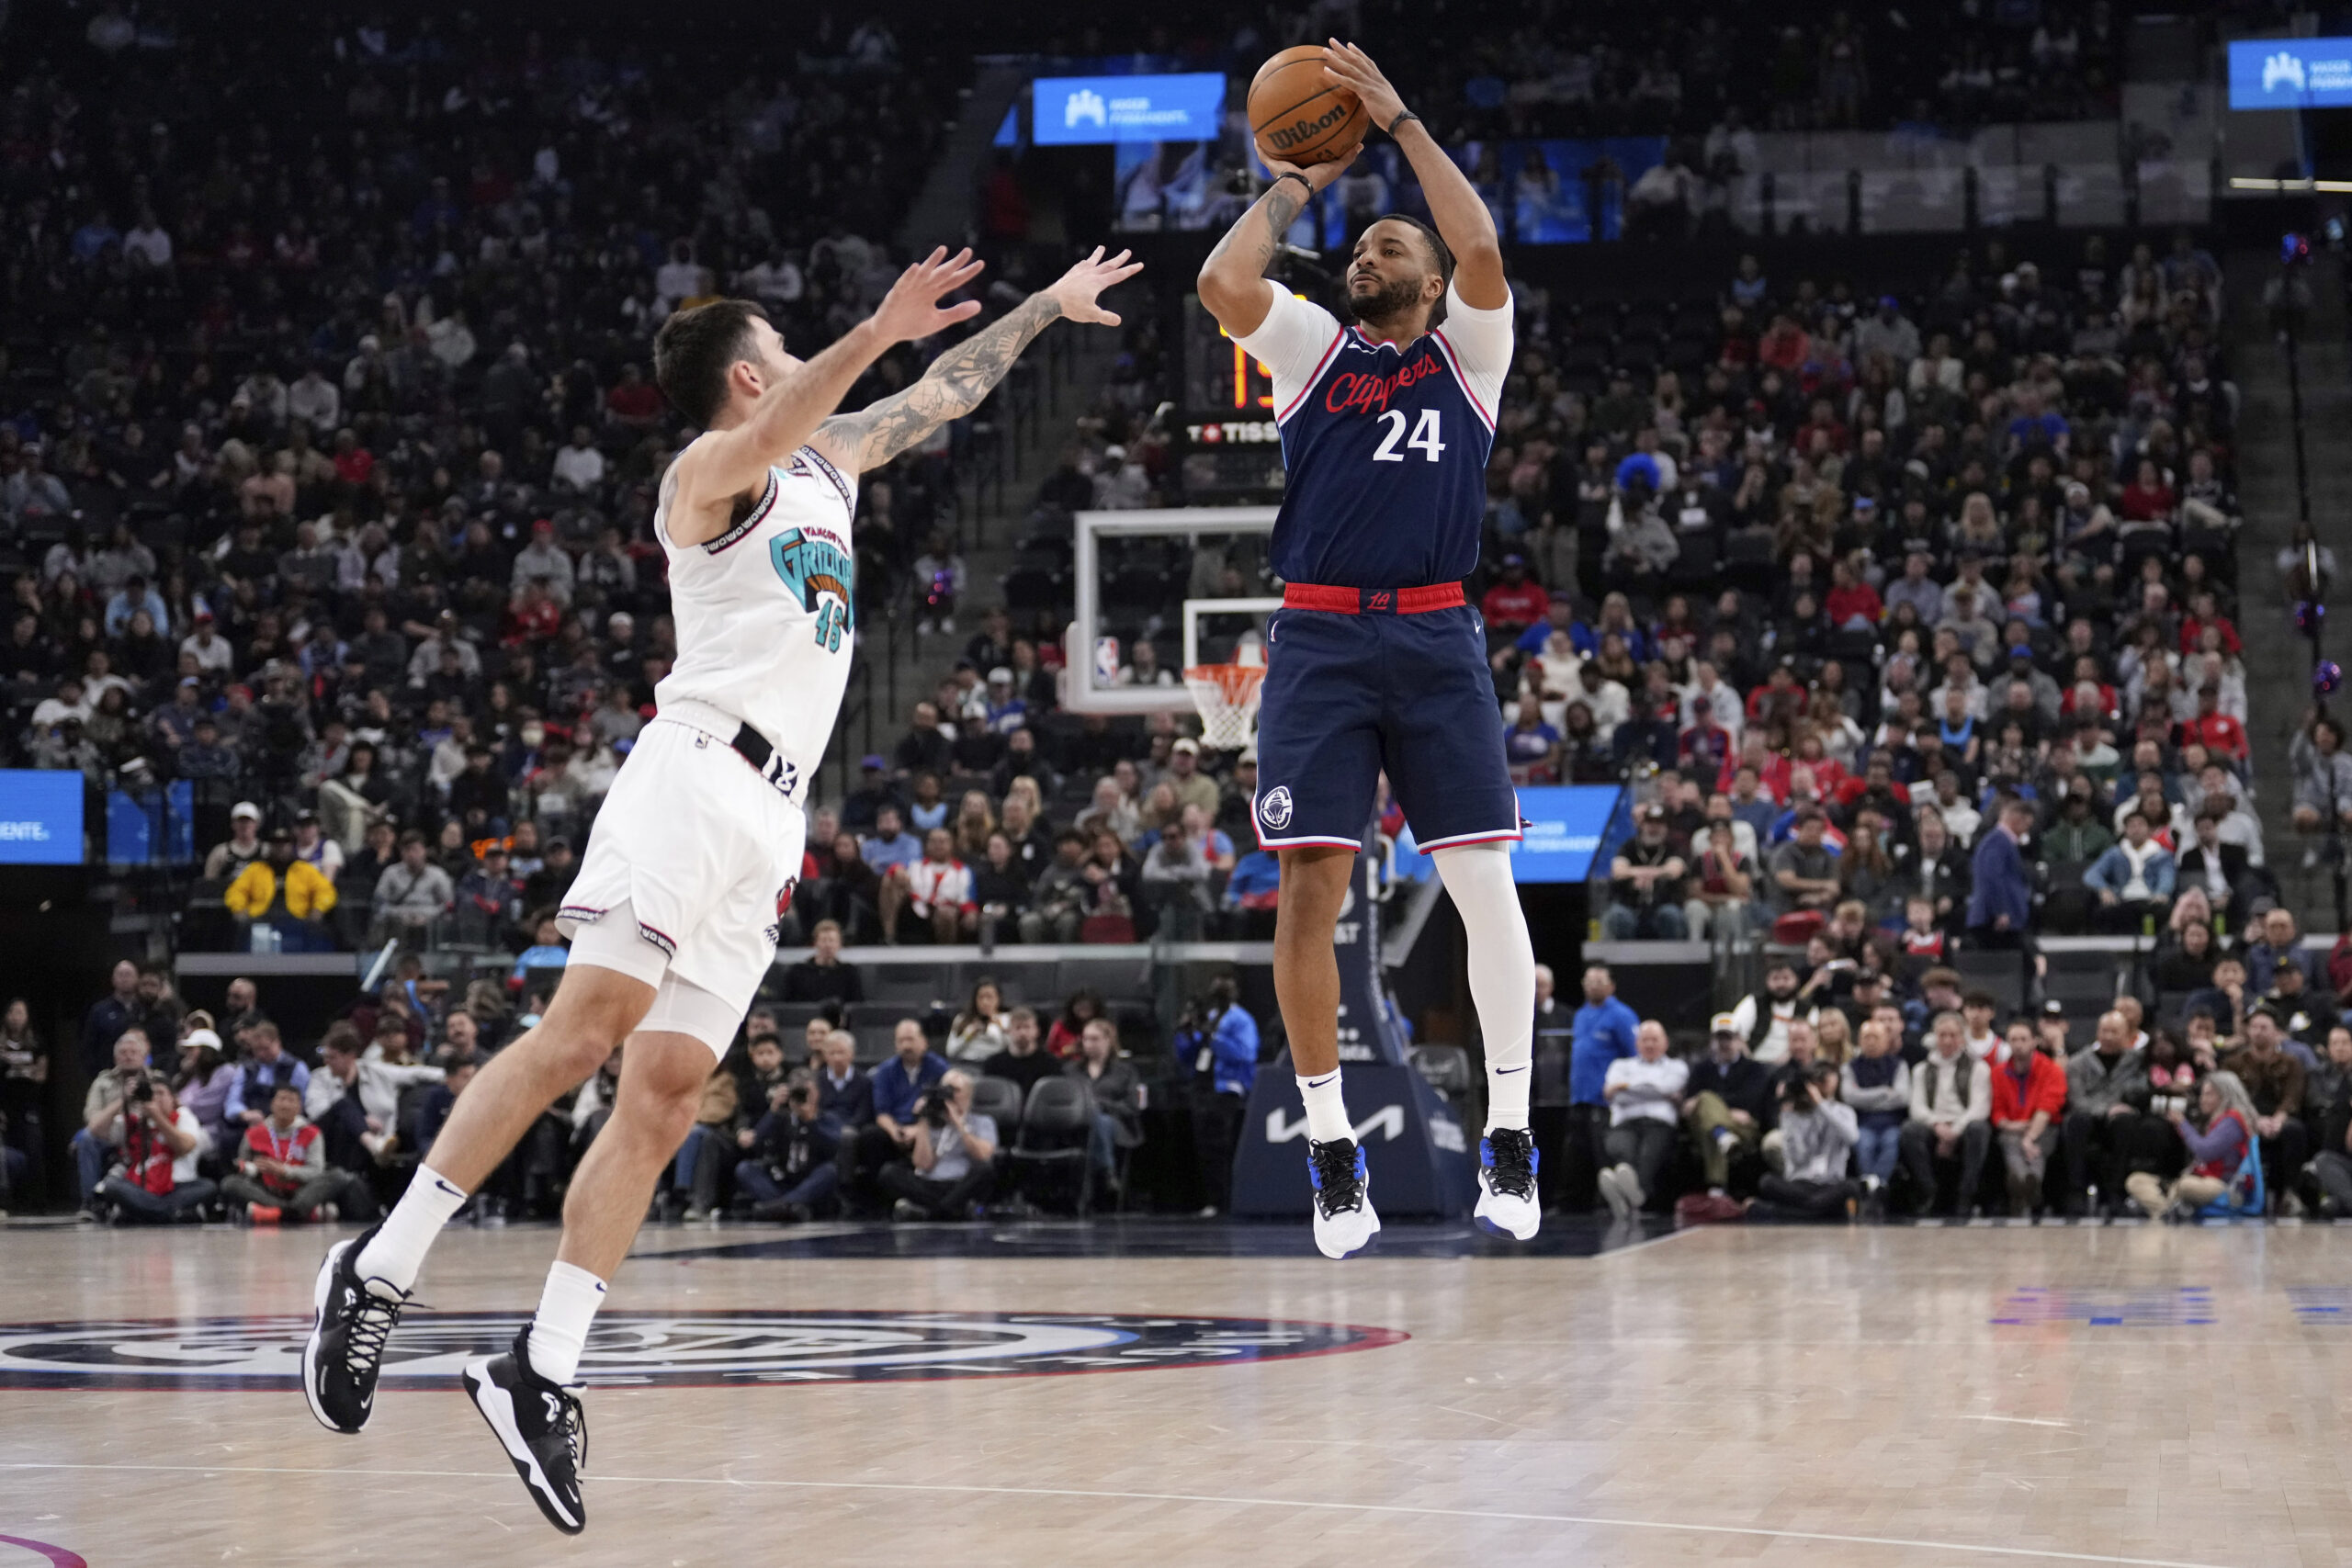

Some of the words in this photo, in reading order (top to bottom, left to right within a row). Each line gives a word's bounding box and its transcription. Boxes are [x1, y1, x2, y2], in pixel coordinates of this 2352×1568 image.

[1268, 104, 1347, 150] Wilson
[1326, 354, 1442, 413] Clippers
[1221, 422, 1281, 443] TISS
[1373, 409, 1446, 462] 24
[815, 599, 843, 654] 46
